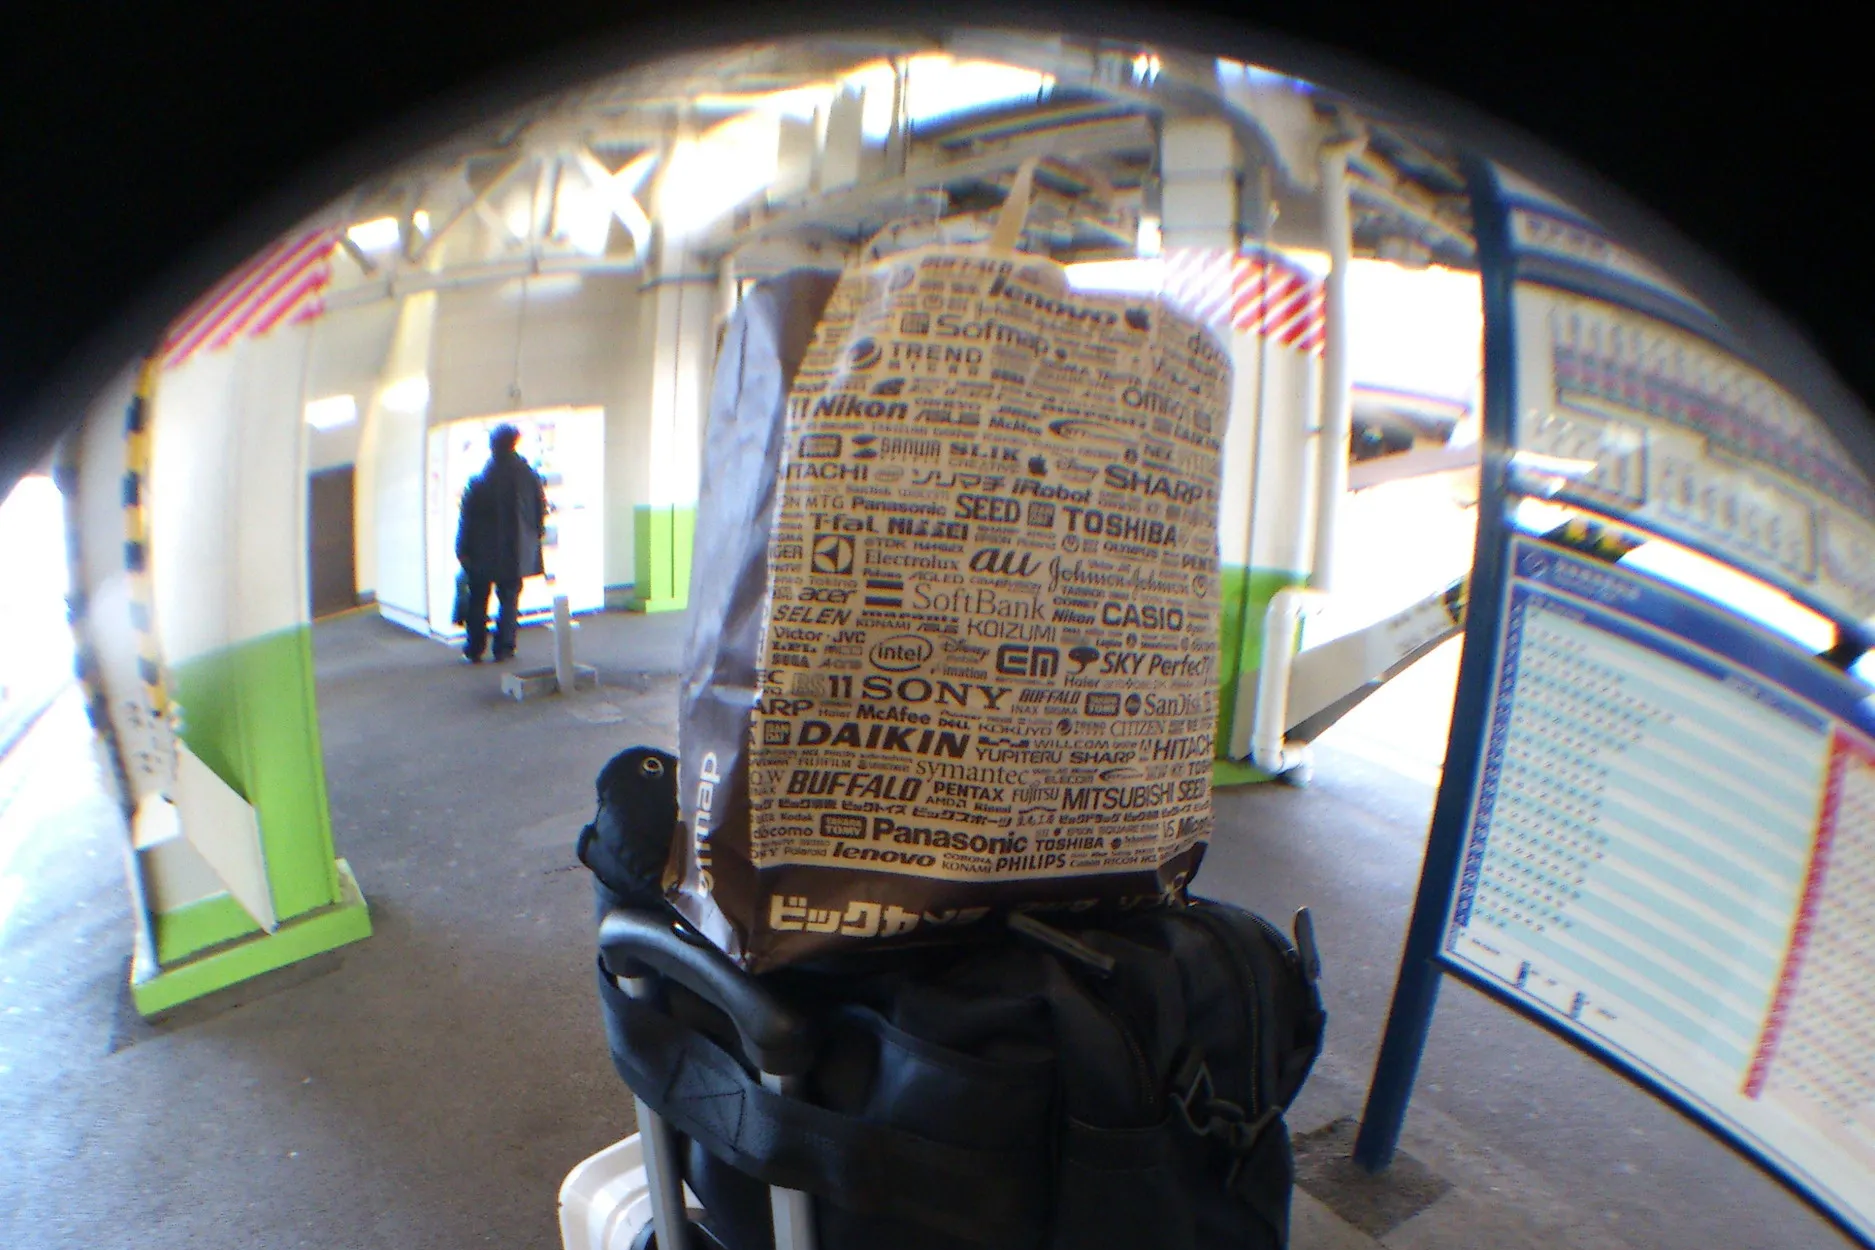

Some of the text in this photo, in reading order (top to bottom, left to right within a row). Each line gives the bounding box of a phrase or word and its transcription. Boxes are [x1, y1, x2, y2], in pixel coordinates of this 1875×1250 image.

[889, 342, 984, 363] TREND
[813, 394, 908, 421] Nikon
[1011, 477, 1090, 504] iRobot
[1104, 463, 1203, 505] SHARP
[851, 495, 946, 516] Panasonic
[955, 492, 1021, 524] SEED
[1062, 503, 1179, 549] TOSHIBA
[865, 548, 960, 571] Electrolux
[969, 547, 1041, 577] au
[798, 586, 857, 604] acer
[911, 582, 1046, 621] SoftBank
[772, 604, 851, 626] SELEN
[1102, 600, 1183, 632] CASIO
[968, 618, 1057, 643] KOIZUMI
[877, 644, 922, 664] intel
[1099, 650, 1147, 675] SKY
[861, 674, 1013, 711] SONY
[1018, 688, 1083, 705] BUFFALO
[856, 703, 932, 726] McAfee
[797, 720, 972, 760] DAIKIN
[978, 722, 1053, 738] KOKUYO
[976, 746, 1062, 765] YUPITERU
[1033, 738, 1110, 751] WILLCOM
[1069, 750, 1137, 765] SHARP
[915, 759, 1029, 787] symantec
[786, 769, 922, 803] BUFFALO
[932, 780, 1004, 803] PENTAX
[1012, 786, 1060, 805] FUJITSU
[1062, 781, 1175, 811] MITSUBISHI
[753, 826, 815, 841] docomo
[872, 816, 1029, 855] Panasonic
[1035, 834, 1105, 854] TOSHIBA
[832, 841, 936, 868] lenovo
[995, 853, 1067, 873] PHILIPS
[941, 860, 994, 875] KONAMI
